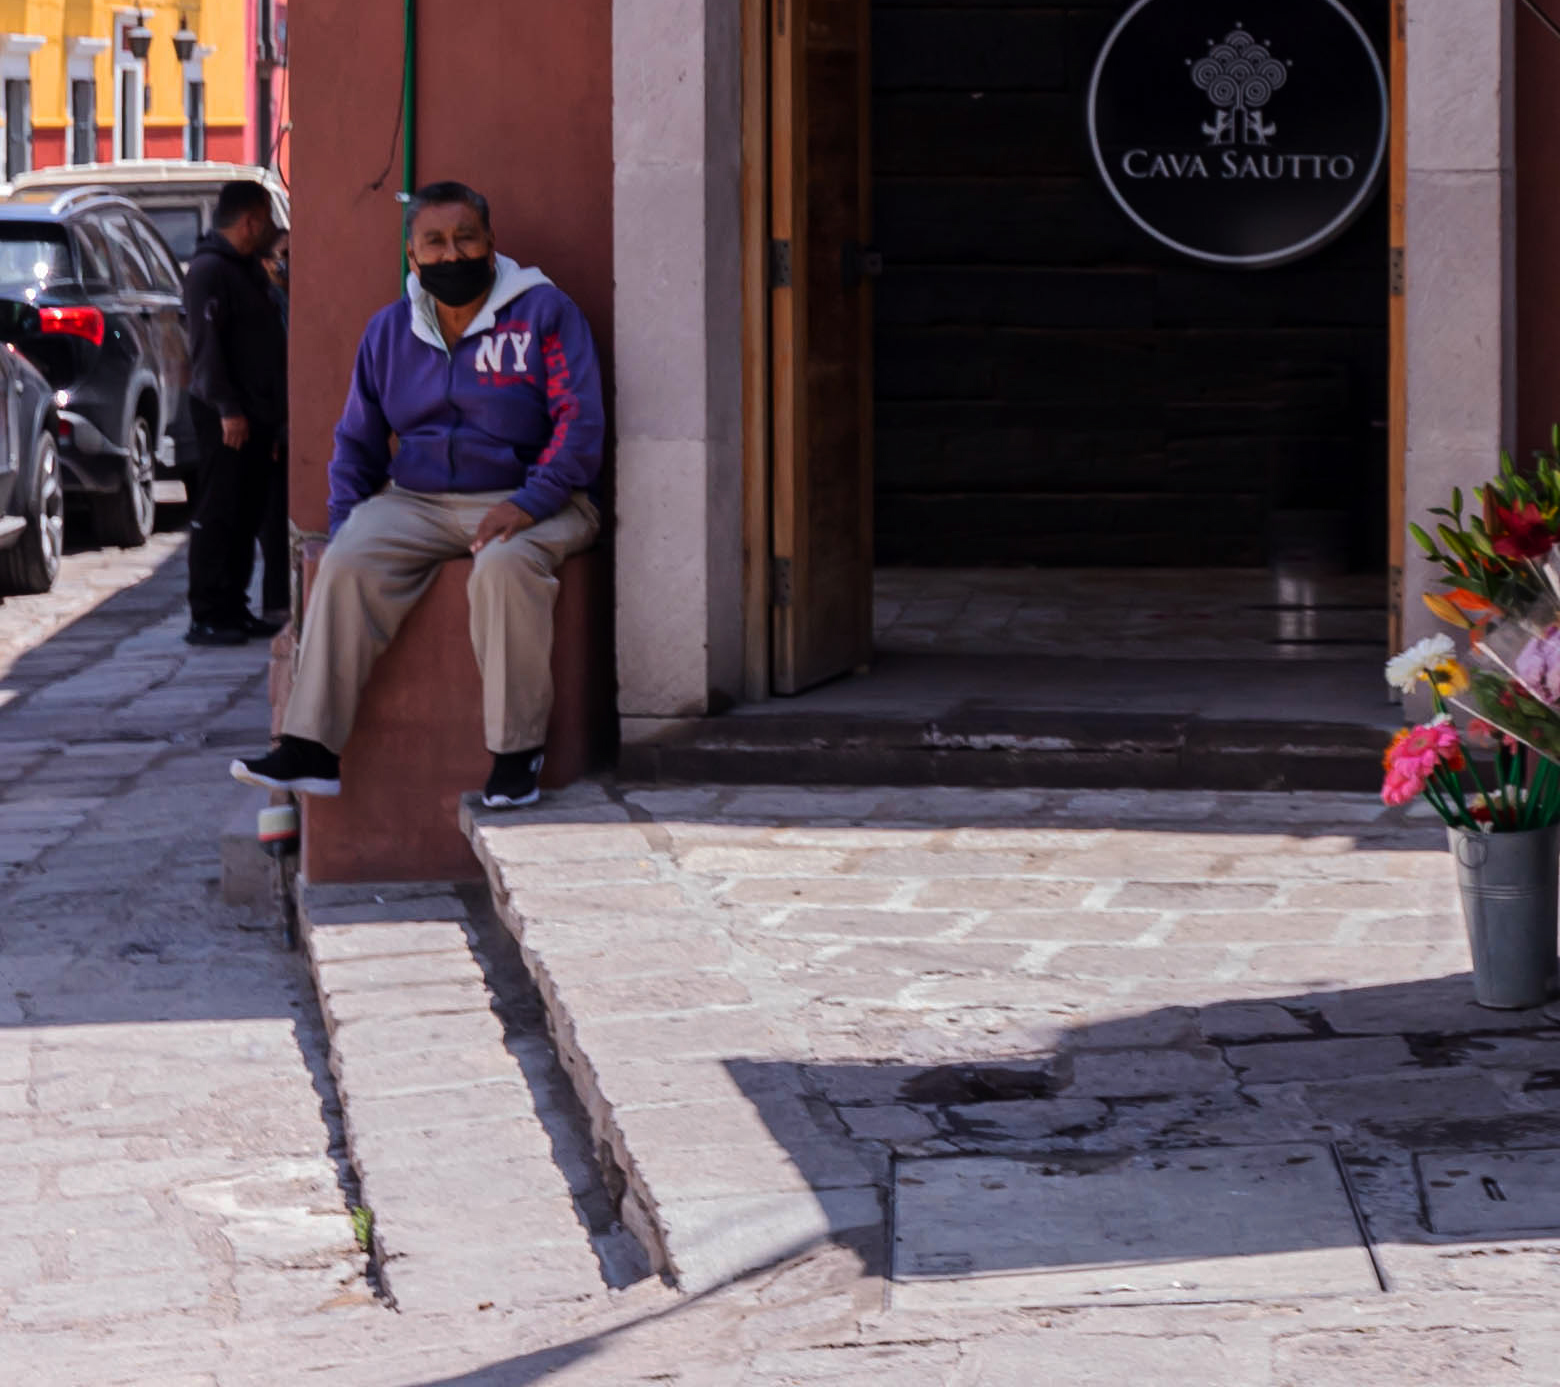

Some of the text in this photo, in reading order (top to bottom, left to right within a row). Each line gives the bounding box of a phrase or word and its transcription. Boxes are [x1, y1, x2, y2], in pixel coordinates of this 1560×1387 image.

[1122, 149, 1355, 178] CAVA SAUTTO
[475, 331, 532, 372] NY
